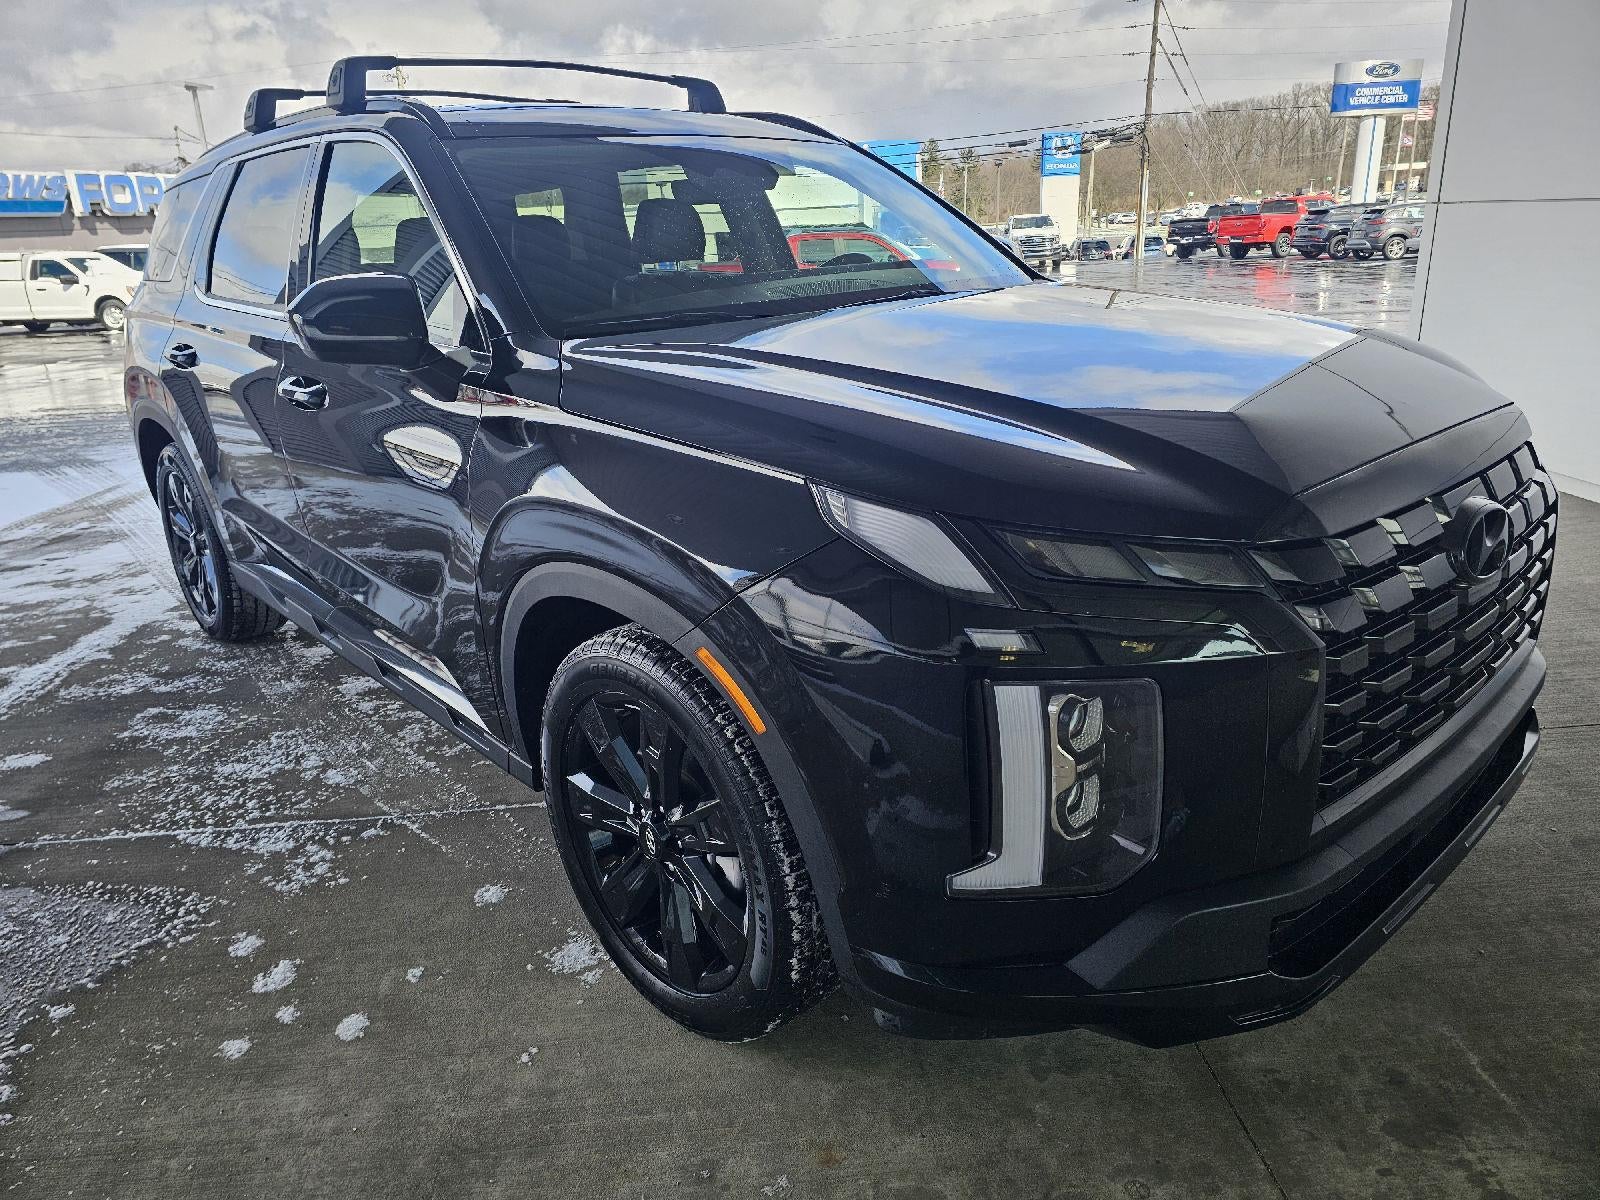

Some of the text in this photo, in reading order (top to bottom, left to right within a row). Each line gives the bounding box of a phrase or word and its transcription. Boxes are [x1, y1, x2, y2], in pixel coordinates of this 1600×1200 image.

[1371, 63, 1397, 76] Ford
[1355, 85, 1404, 96] COMMERCIAL
[1349, 93, 1408, 105] VEHICLE CENTER
[68, 172, 177, 216] FOR
